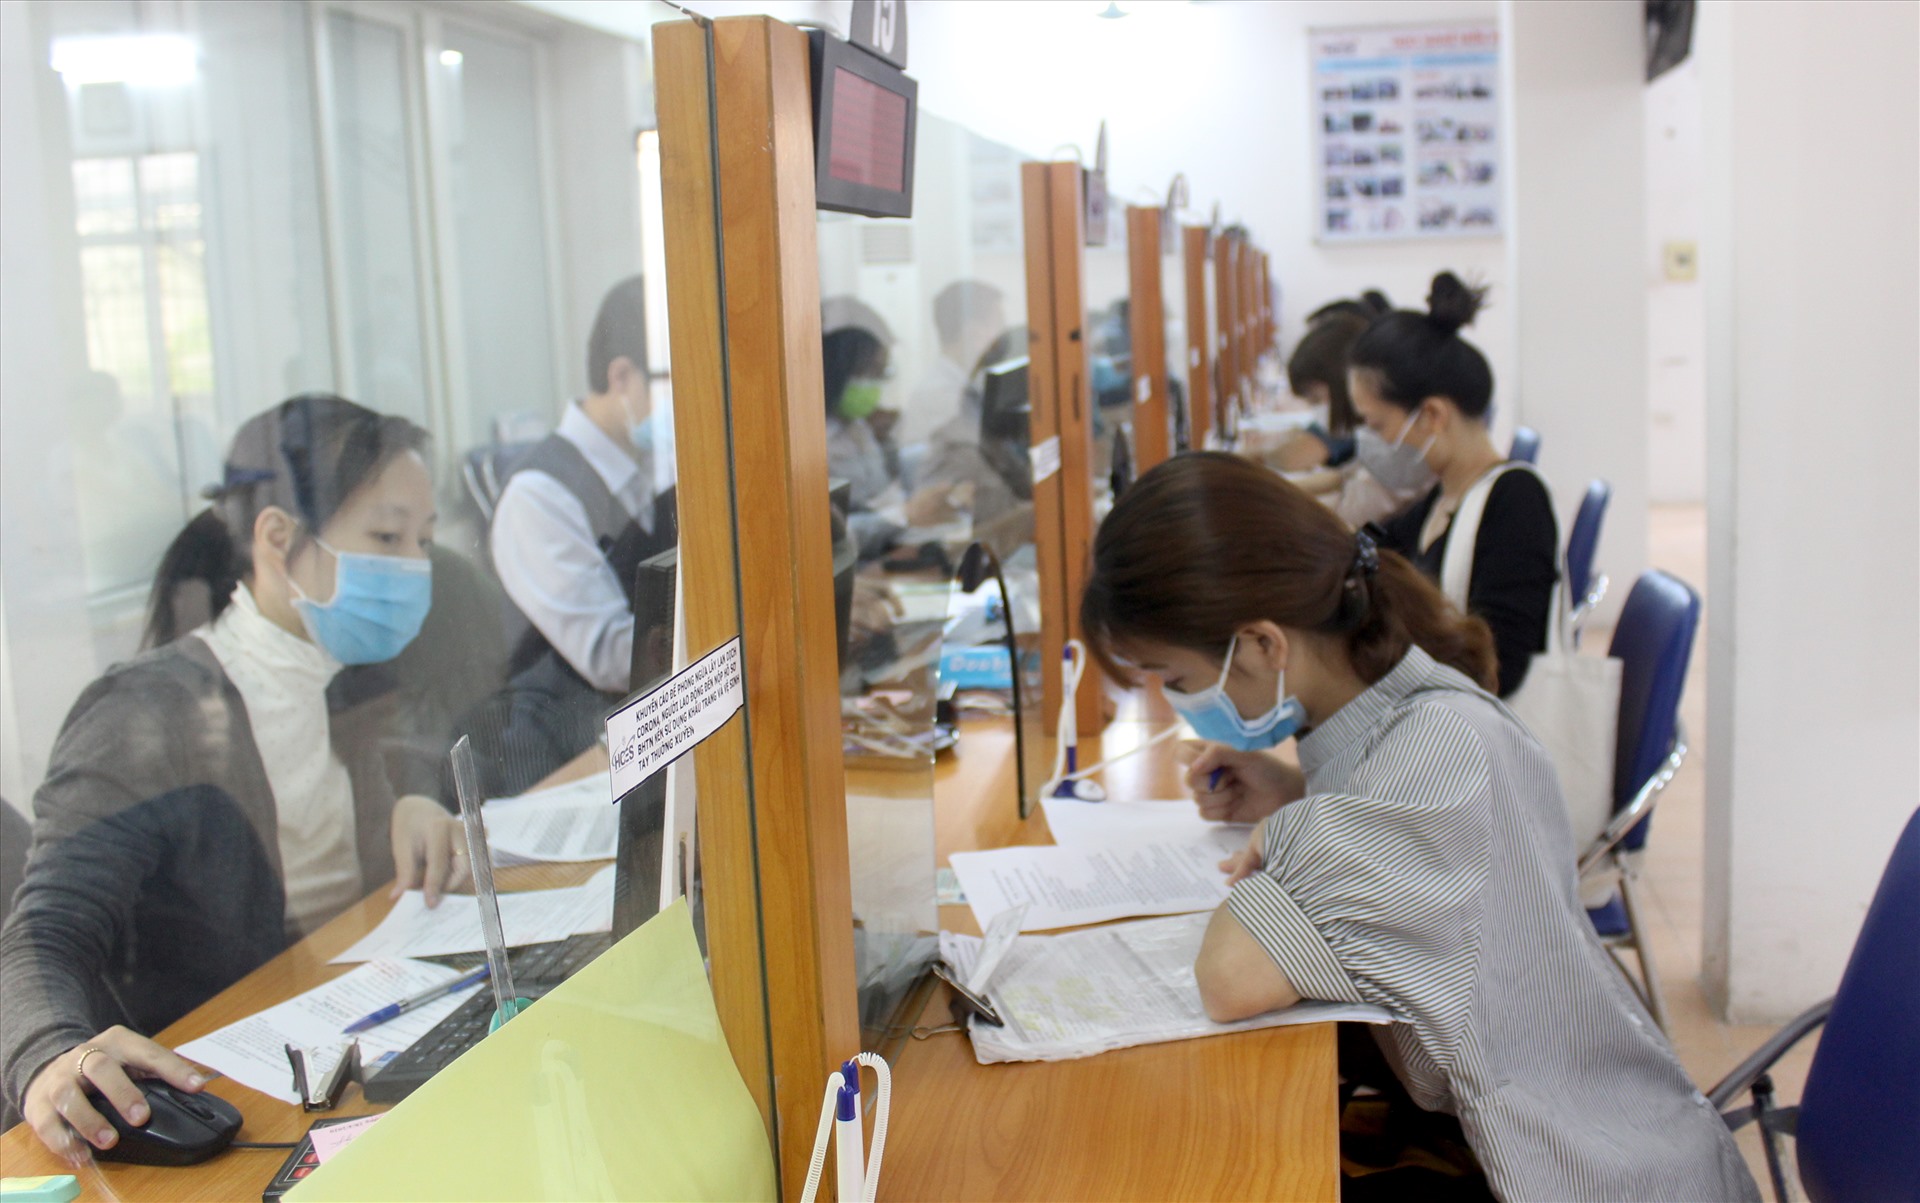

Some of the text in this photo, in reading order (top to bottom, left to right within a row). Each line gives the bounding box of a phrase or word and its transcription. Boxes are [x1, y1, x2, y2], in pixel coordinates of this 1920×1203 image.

[659, 690, 669, 706] CÁO
[717, 654, 725, 668] LAN
[679, 694, 689, 710] LAO
[637, 736, 653, 755] BHTN
[702, 690, 717, 710] TRANG
[638, 754, 650, 772] TAY
